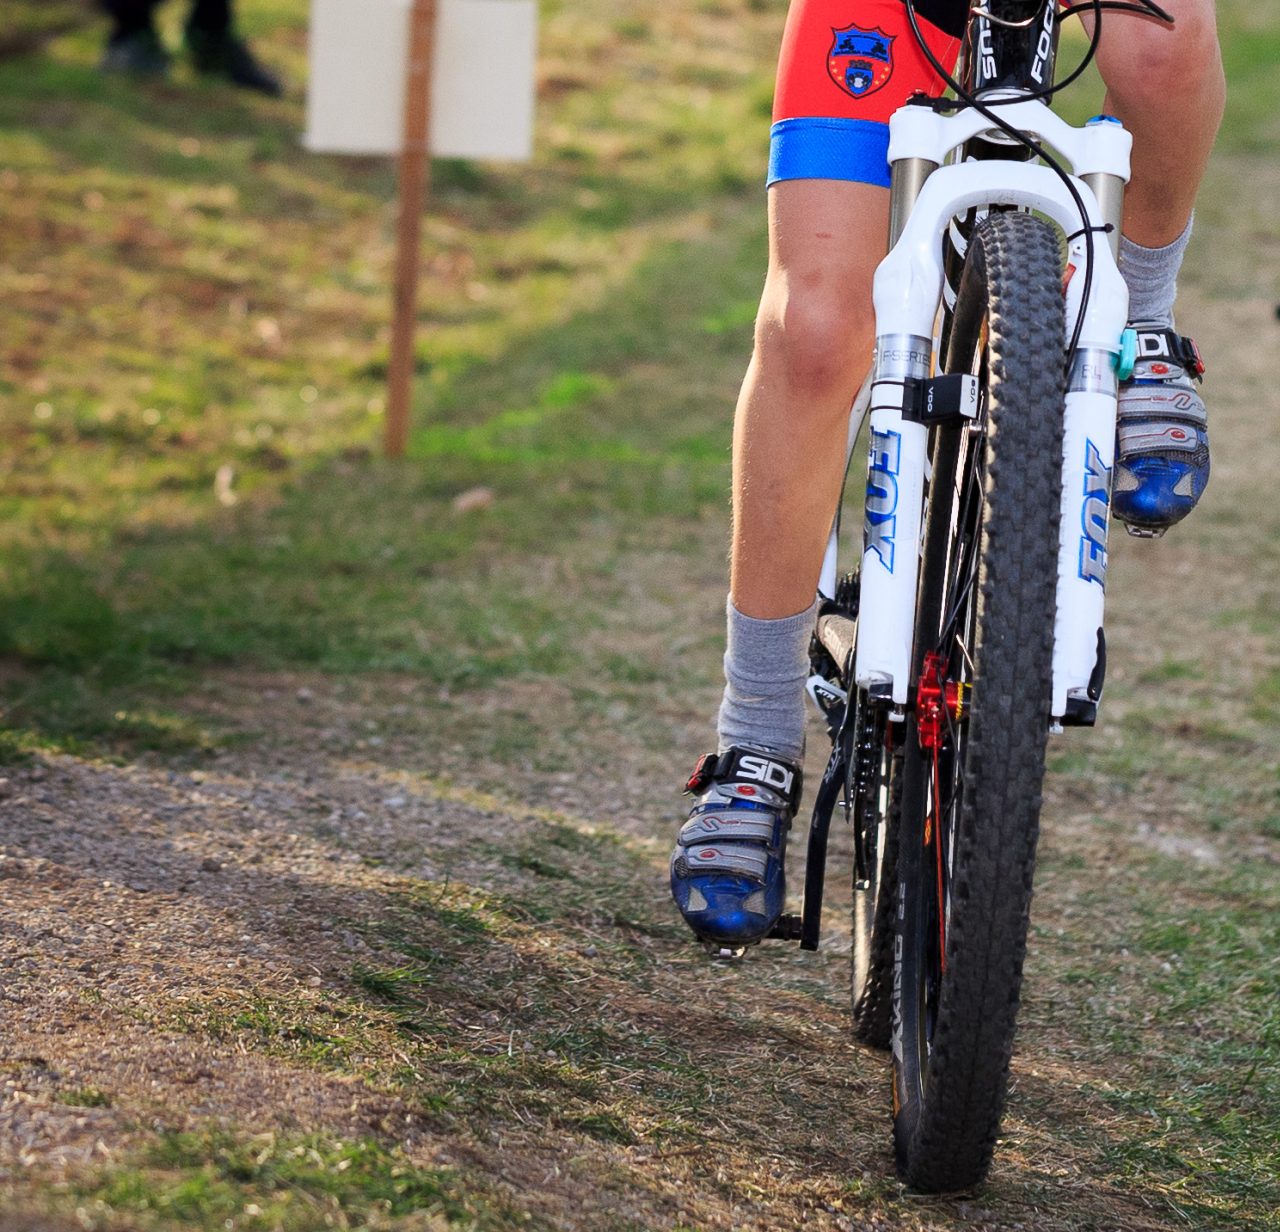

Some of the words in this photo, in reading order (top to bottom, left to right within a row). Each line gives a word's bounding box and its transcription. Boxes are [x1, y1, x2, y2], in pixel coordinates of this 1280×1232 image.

[926, 386, 934, 413] VDO
[864, 425, 902, 575] FOX
[1078, 437, 1112, 590] FOX
[736, 755, 795, 795] SIDI
